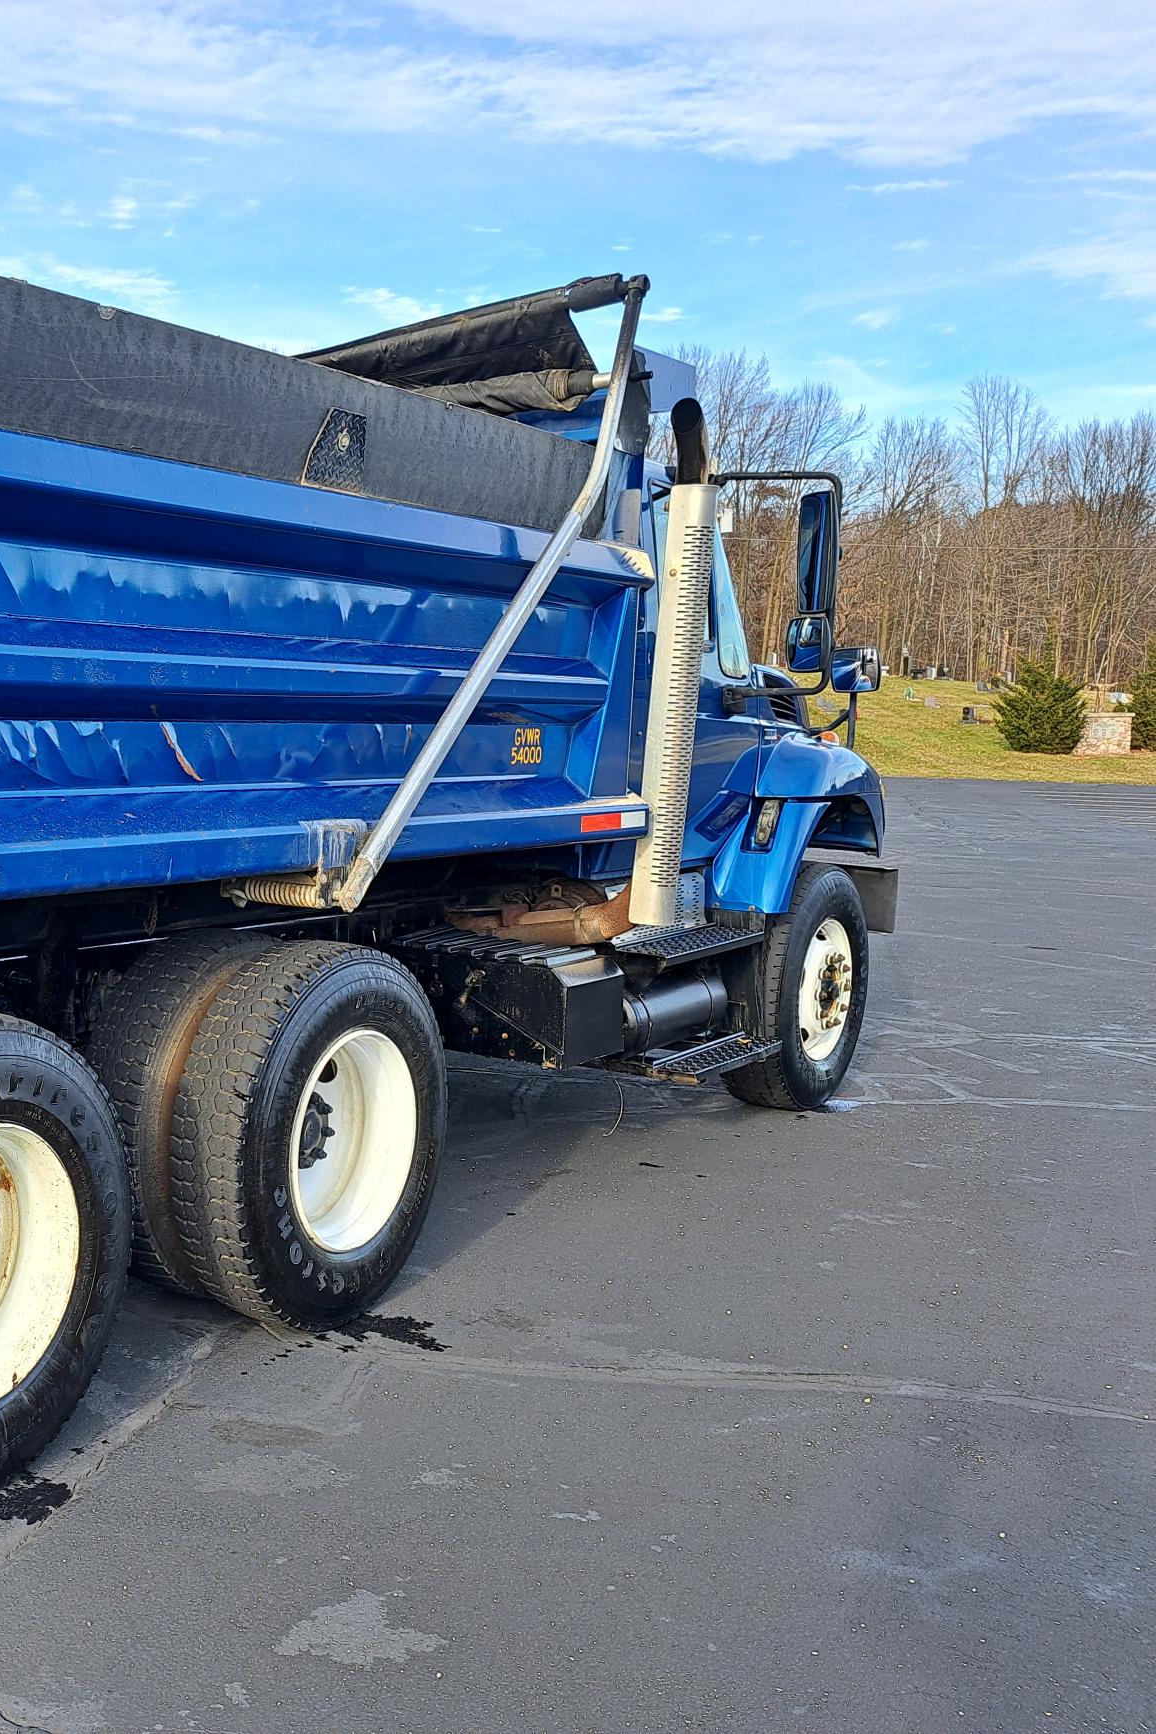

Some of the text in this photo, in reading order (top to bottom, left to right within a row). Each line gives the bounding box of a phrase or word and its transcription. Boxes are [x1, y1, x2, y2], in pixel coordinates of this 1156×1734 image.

[515, 728, 541, 746] GVWR
[510, 746, 542, 765] 54000
[273, 1184, 392, 1295] Firestone
